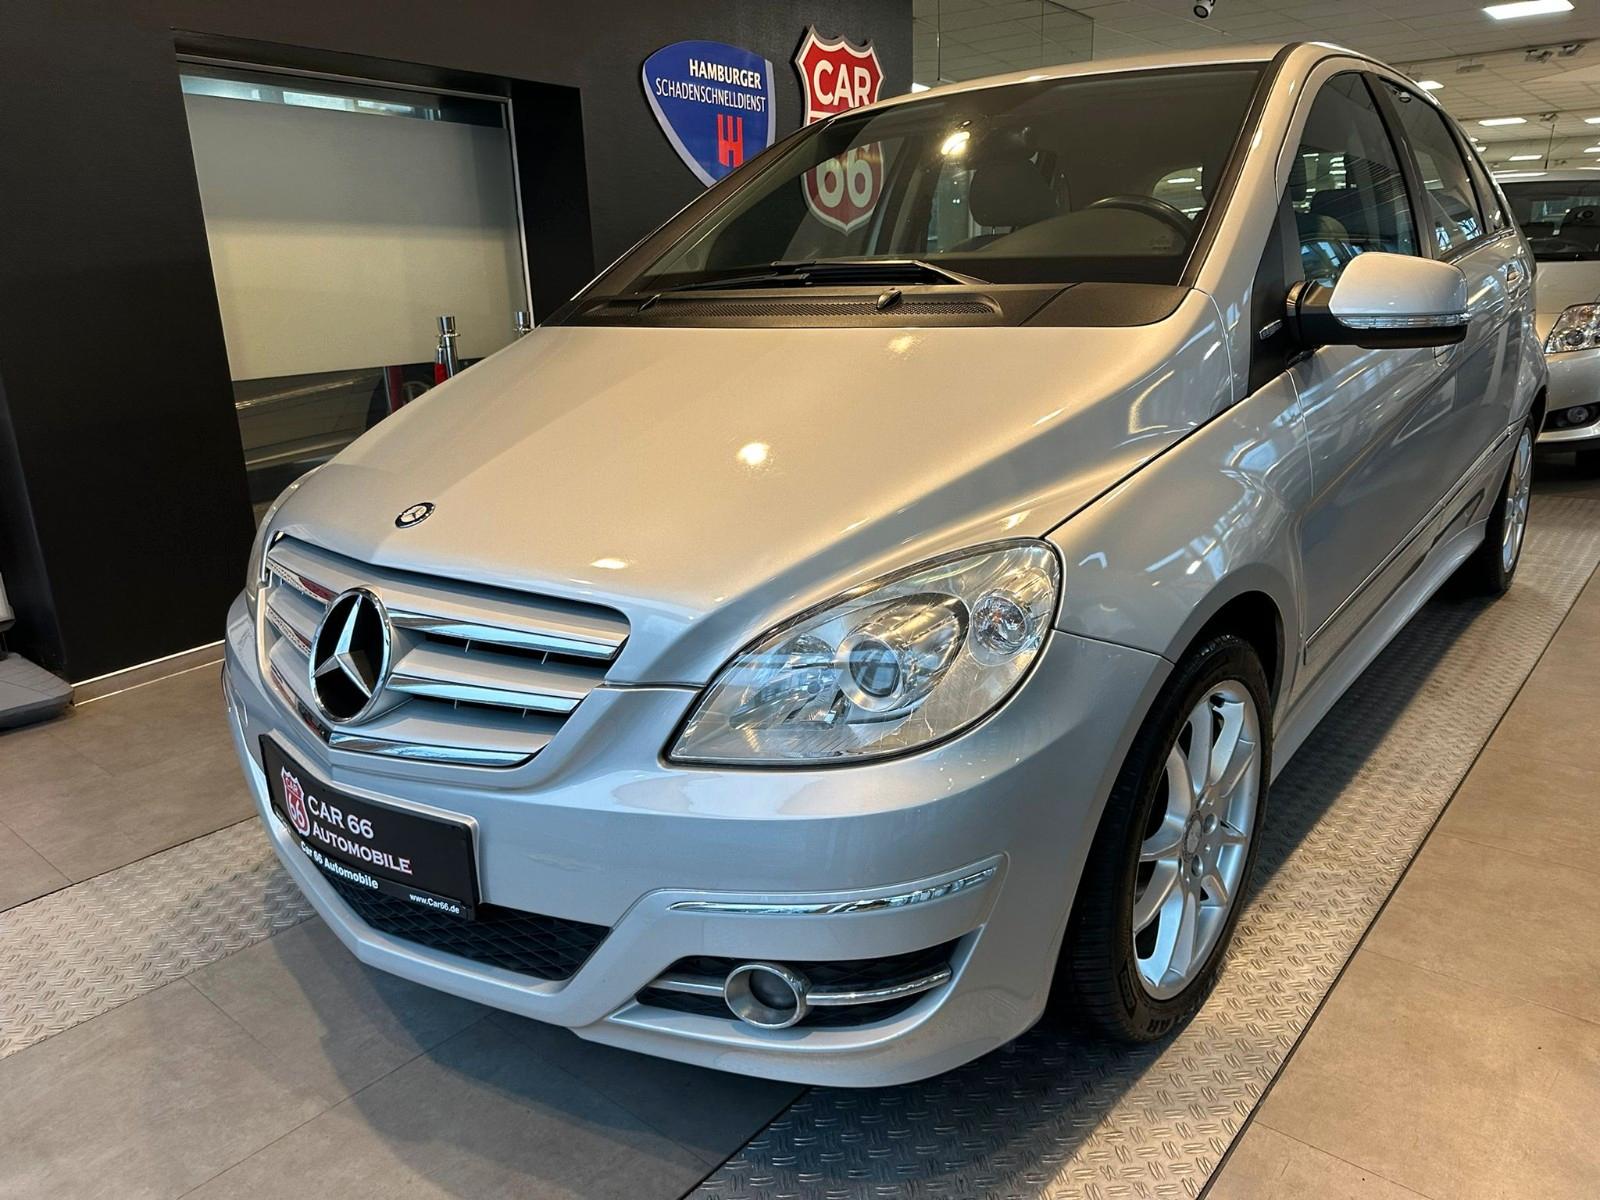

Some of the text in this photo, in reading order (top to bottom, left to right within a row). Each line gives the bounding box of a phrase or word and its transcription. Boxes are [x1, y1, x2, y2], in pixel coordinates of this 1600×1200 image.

[655, 77, 766, 112] SCHADENSCHNELLDIENST
[689, 58, 762, 89] HAMBURGER
[813, 60, 871, 108] CAR
[816, 144, 873, 208] 66
[288, 792, 306, 829] 66
[307, 795, 345, 829] CAR
[347, 814, 375, 839] 66
[300, 840, 379, 890] Car 66 Automobile
[313, 821, 413, 875] AUTOMOBILE
[409, 893, 460, 915] www.Car66.de
